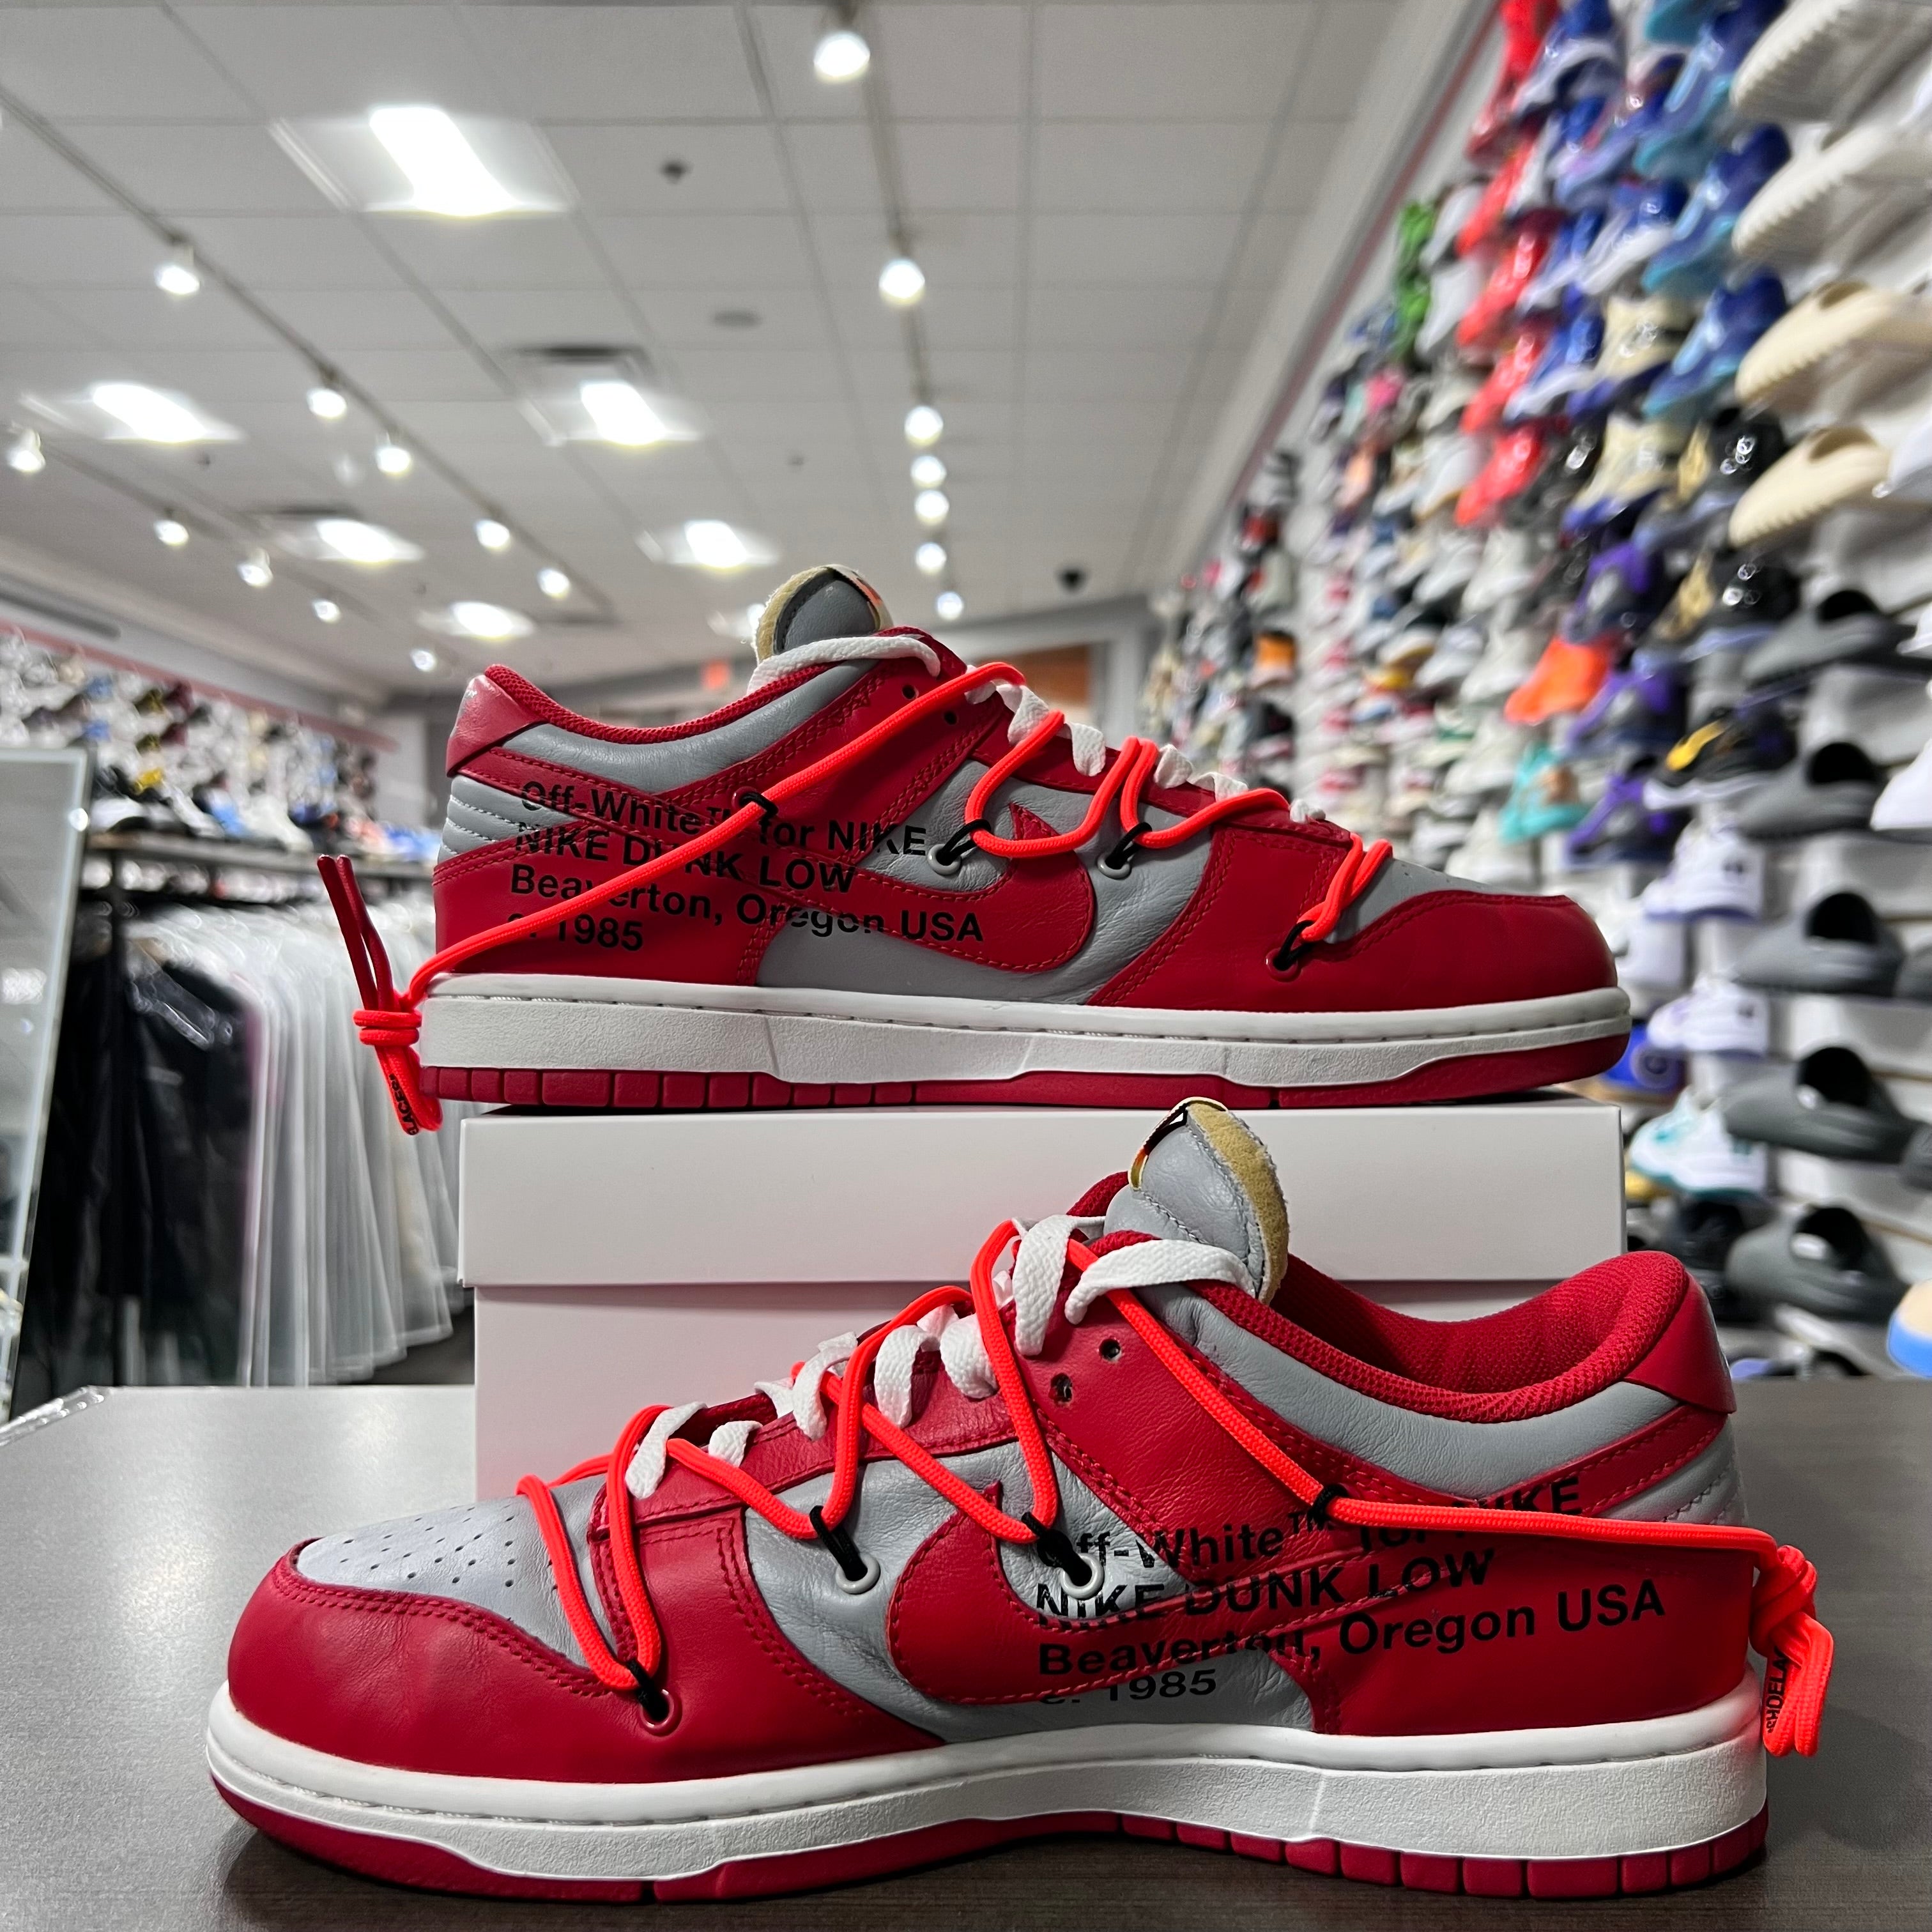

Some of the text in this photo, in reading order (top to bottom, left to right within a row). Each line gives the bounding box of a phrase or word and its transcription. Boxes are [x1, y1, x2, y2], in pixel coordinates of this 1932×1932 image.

[515, 822, 610, 861] NIKE
[759, 855, 856, 893] LOW
[828, 820, 926, 855] NIKE
[558, 914, 643, 951] 1985
[736, 894, 885, 937] Oregon
[900, 909, 984, 942] USA
[1185, 1566, 1345, 1616] DUNK
[1367, 1546, 1496, 1598] LOW
[1339, 1604, 1536, 1654] Oregon
[1556, 1578, 1666, 1632] USA
[1106, 1669, 1216, 1701] 1985
